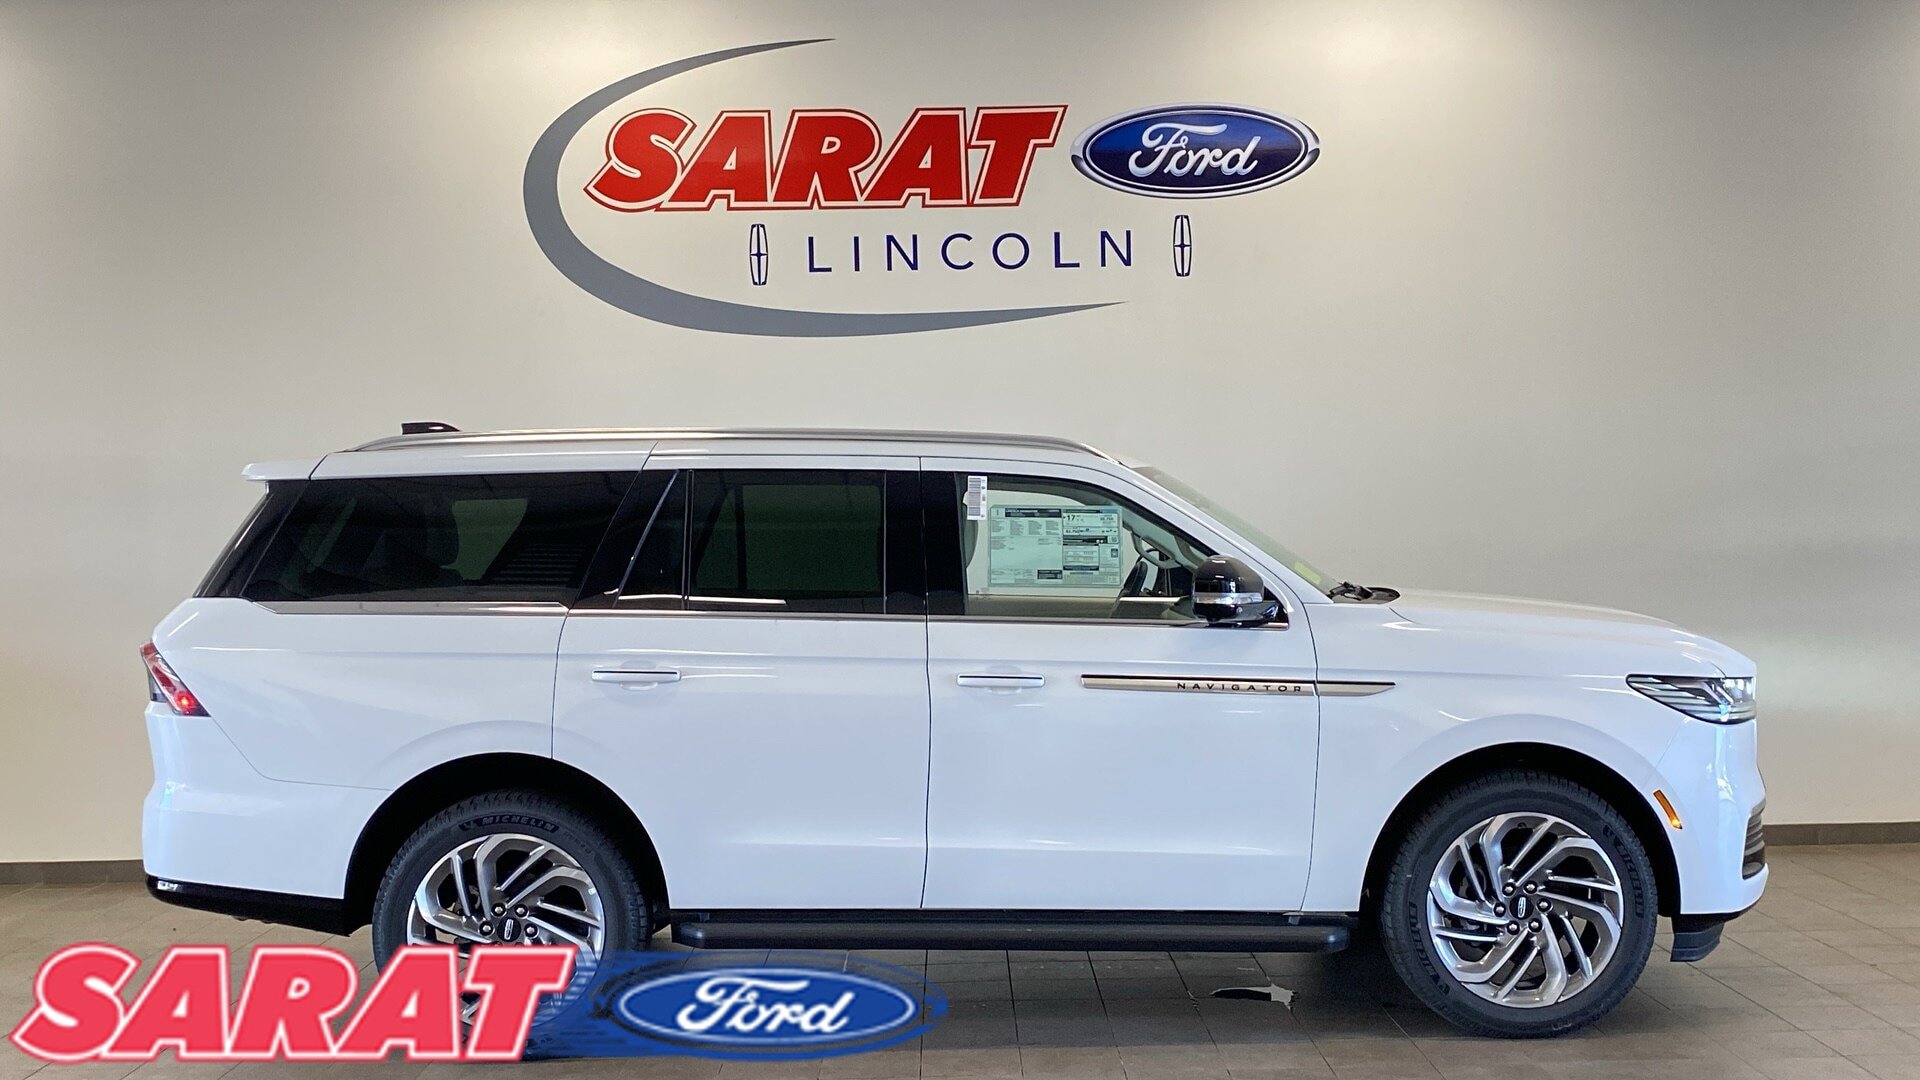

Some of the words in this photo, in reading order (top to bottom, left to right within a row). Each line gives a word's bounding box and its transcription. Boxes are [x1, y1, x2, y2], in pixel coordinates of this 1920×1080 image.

[583, 105, 1068, 213] SARAT
[1128, 122, 1262, 178] Ford
[808, 230, 1133, 273] LINCOLN
[1176, 682, 1302, 693] NAVIGATOR
[481, 814, 555, 832] MICHELIN
